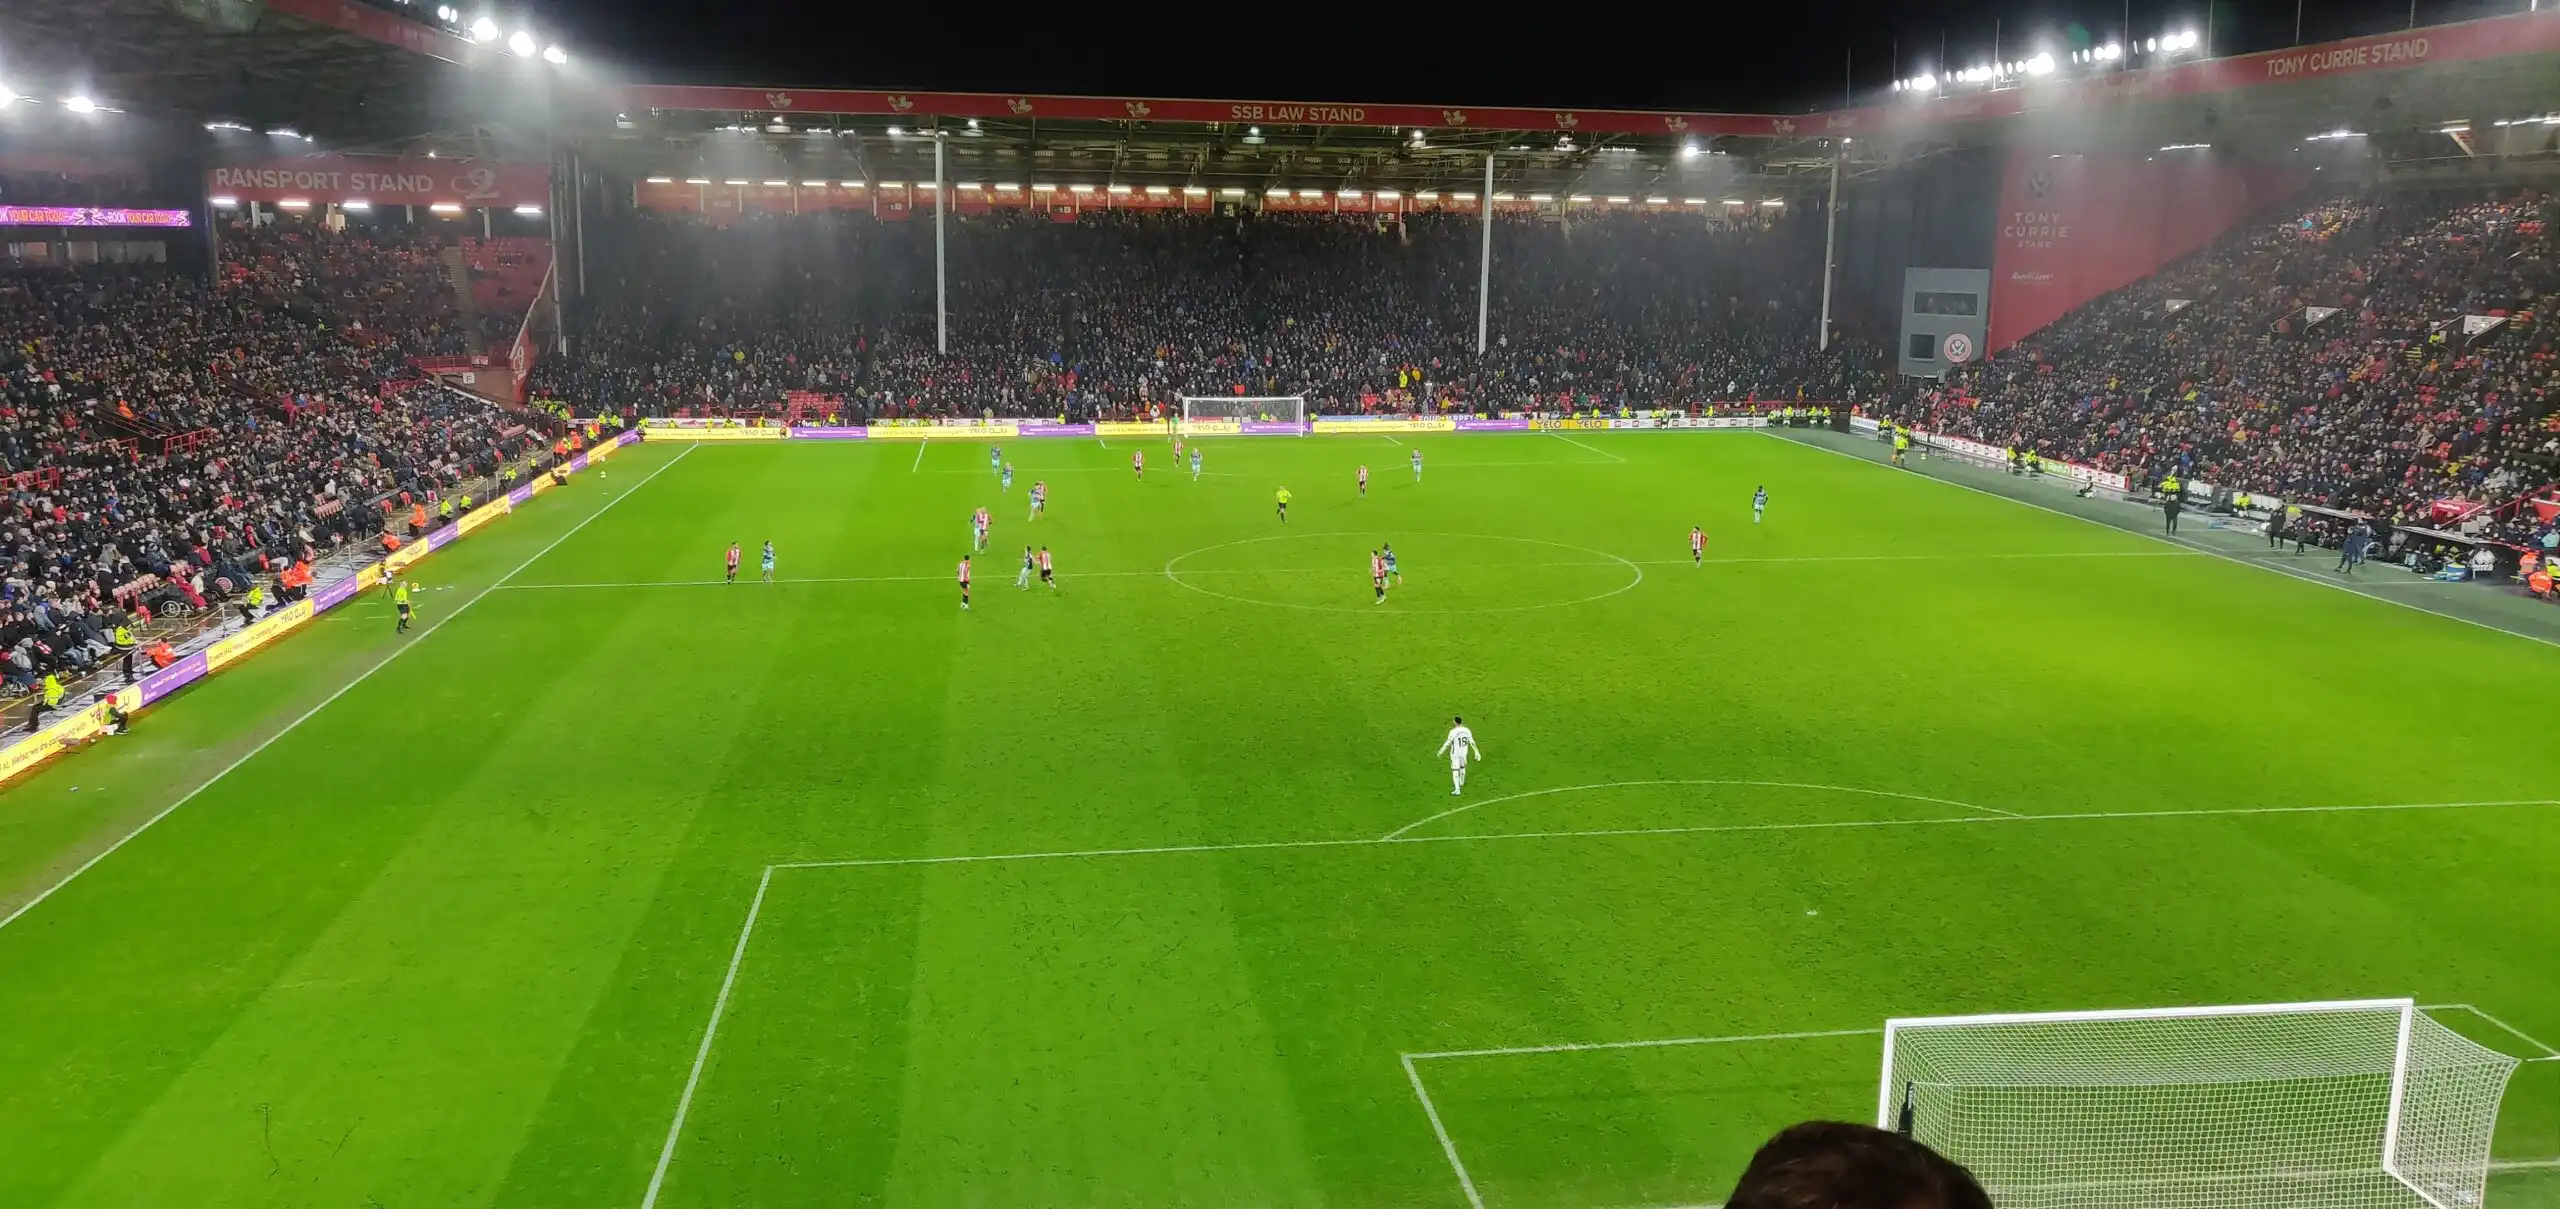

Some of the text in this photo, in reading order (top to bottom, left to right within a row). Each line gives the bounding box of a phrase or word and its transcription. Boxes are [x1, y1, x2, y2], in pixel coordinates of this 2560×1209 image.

[2266, 38, 2428, 77] TONY CURRIE STAND
[1231, 105, 1365, 122] SSB LAW STAND
[351, 173, 434, 193] STAND
[108, 211, 126, 223] BOOK
[2014, 212, 2060, 224] TONY
[2004, 226, 2068, 238] CURRIE
[1536, 420, 1562, 429] YELO
[1576, 420, 1602, 429] YELO
